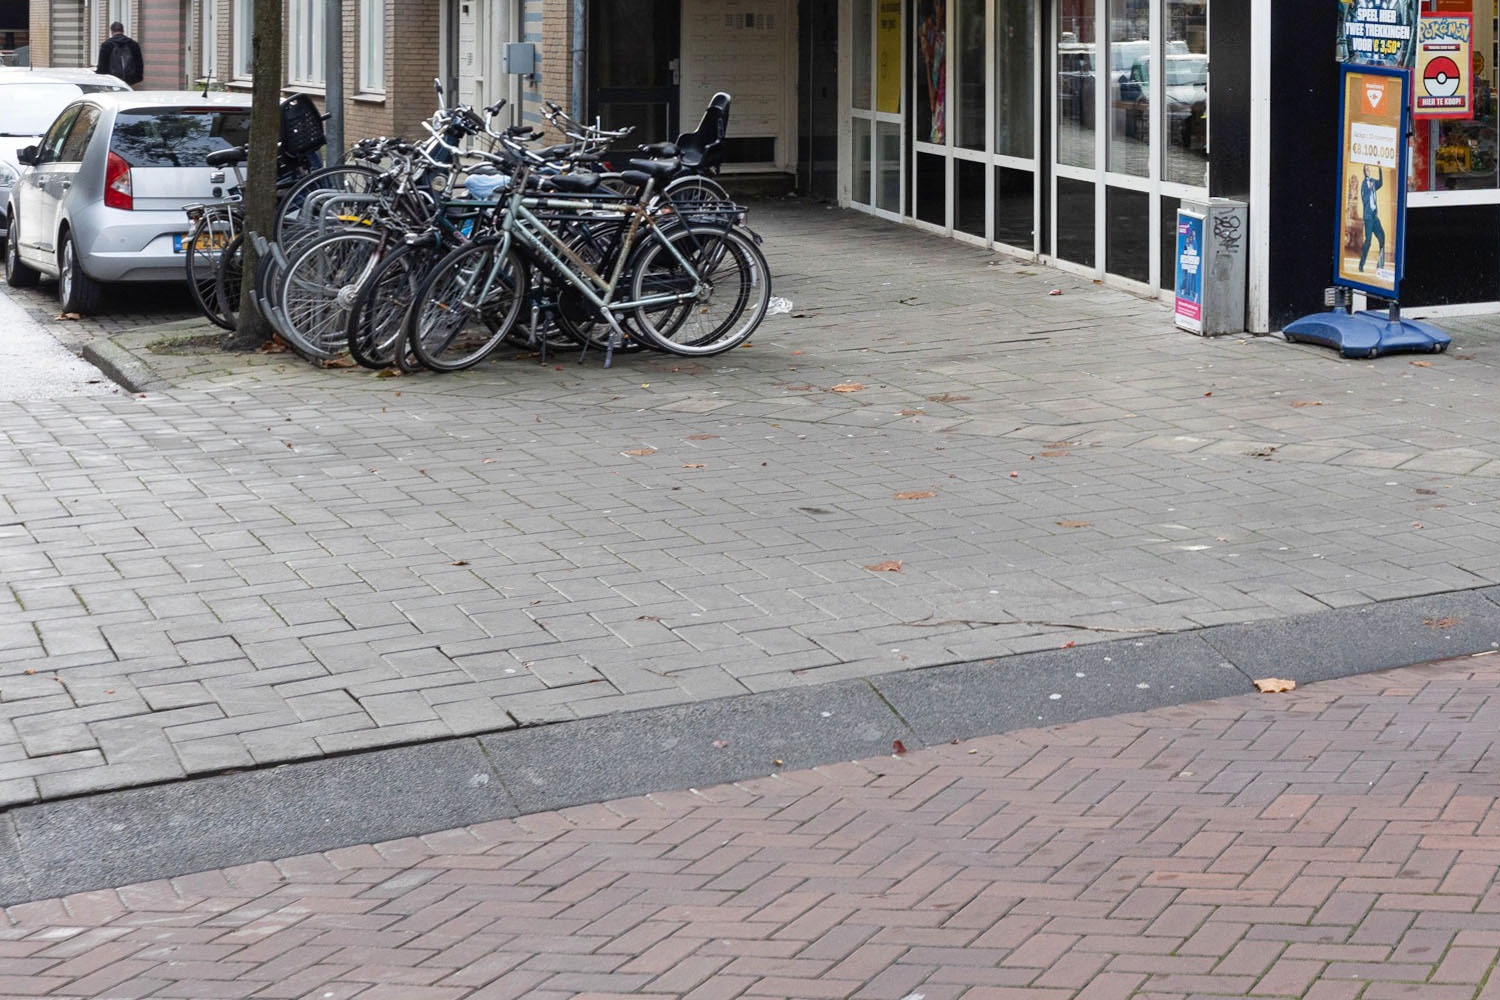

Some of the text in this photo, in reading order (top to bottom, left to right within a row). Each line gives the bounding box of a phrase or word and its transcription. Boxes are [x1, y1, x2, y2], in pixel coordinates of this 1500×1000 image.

[1357, 8, 1397, 23] SPEEL HIER
[1345, 22, 1410, 39] TWEE TREKKINGEN
[1352, 38, 1373, 52] VOOR
